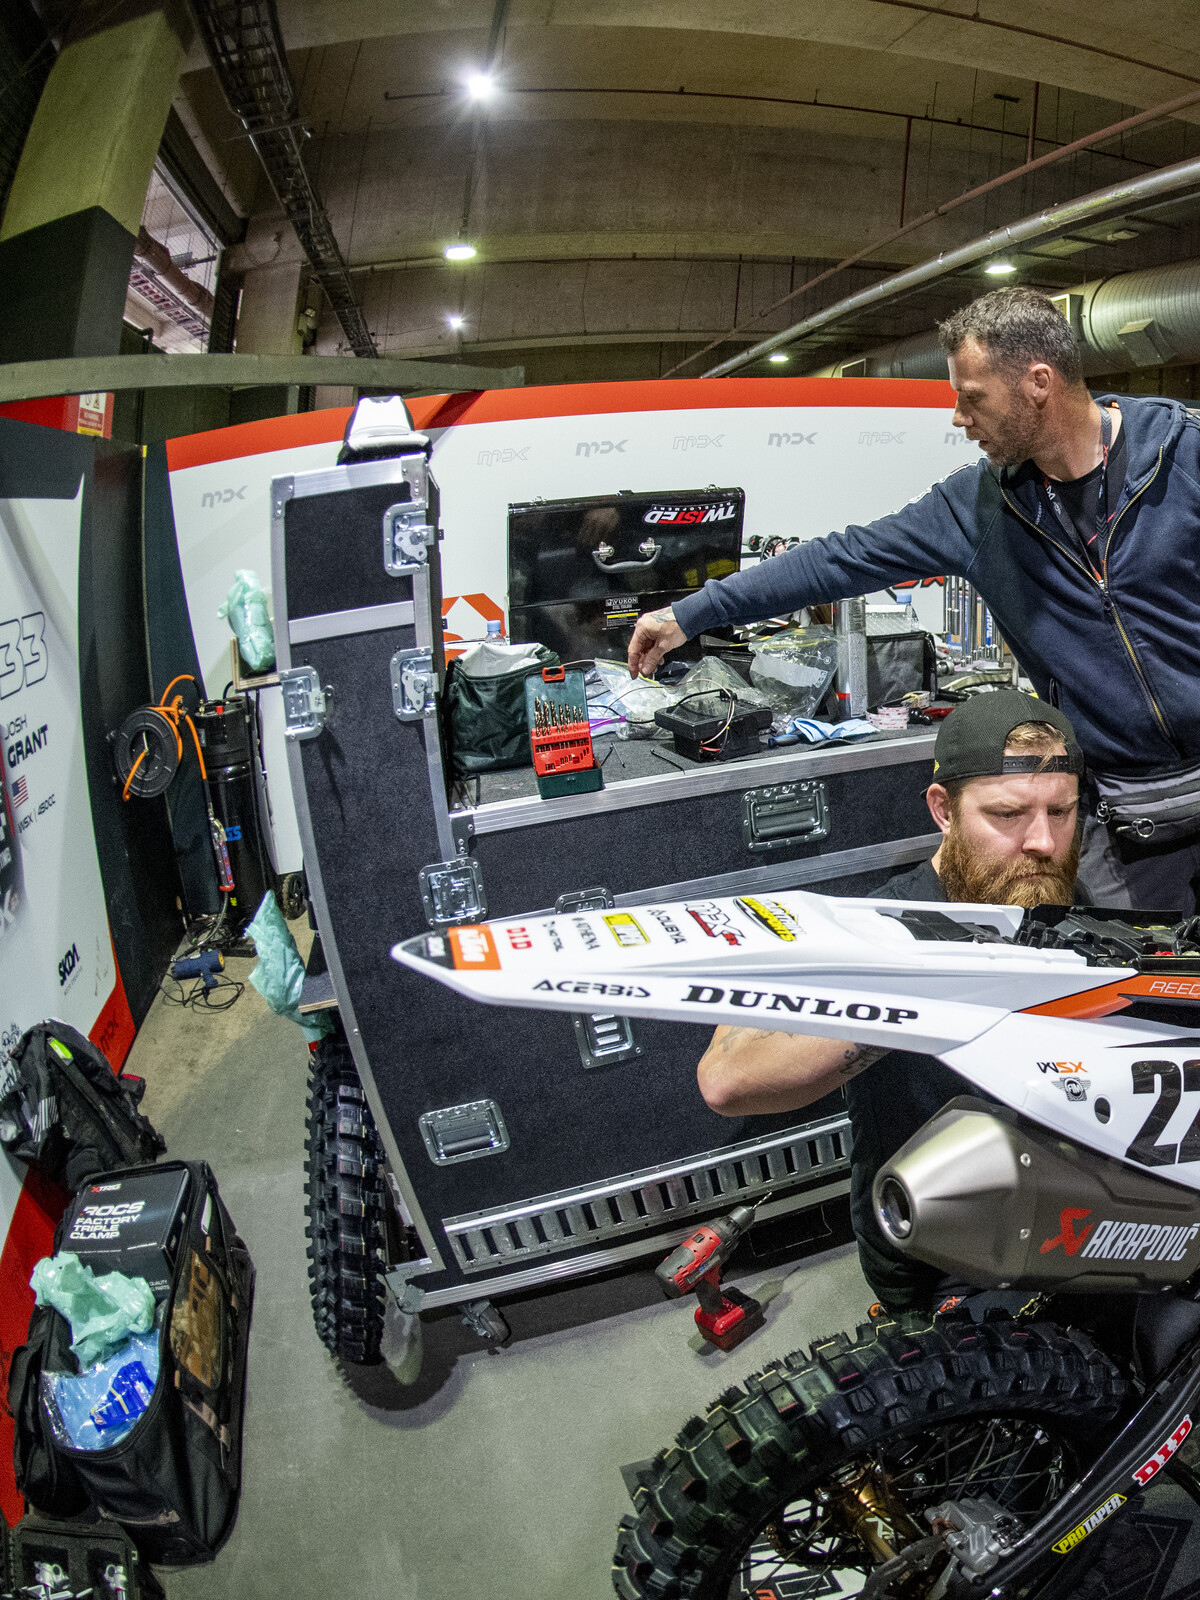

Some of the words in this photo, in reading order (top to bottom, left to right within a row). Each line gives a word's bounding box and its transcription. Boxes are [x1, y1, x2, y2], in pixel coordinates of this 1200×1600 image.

[644, 505, 737, 525] TWISTED
[5, 714, 28, 741] JOSH
[7, 723, 49, 769] GRANT
[680, 984, 919, 1025] DUNLOP
[90, 1183, 122, 1193] XTRIG
[75, 1213, 141, 1226] FACTORY
[69, 1231, 120, 1240] CLAMP
[73, 1224, 119, 1232] TRIPLE
